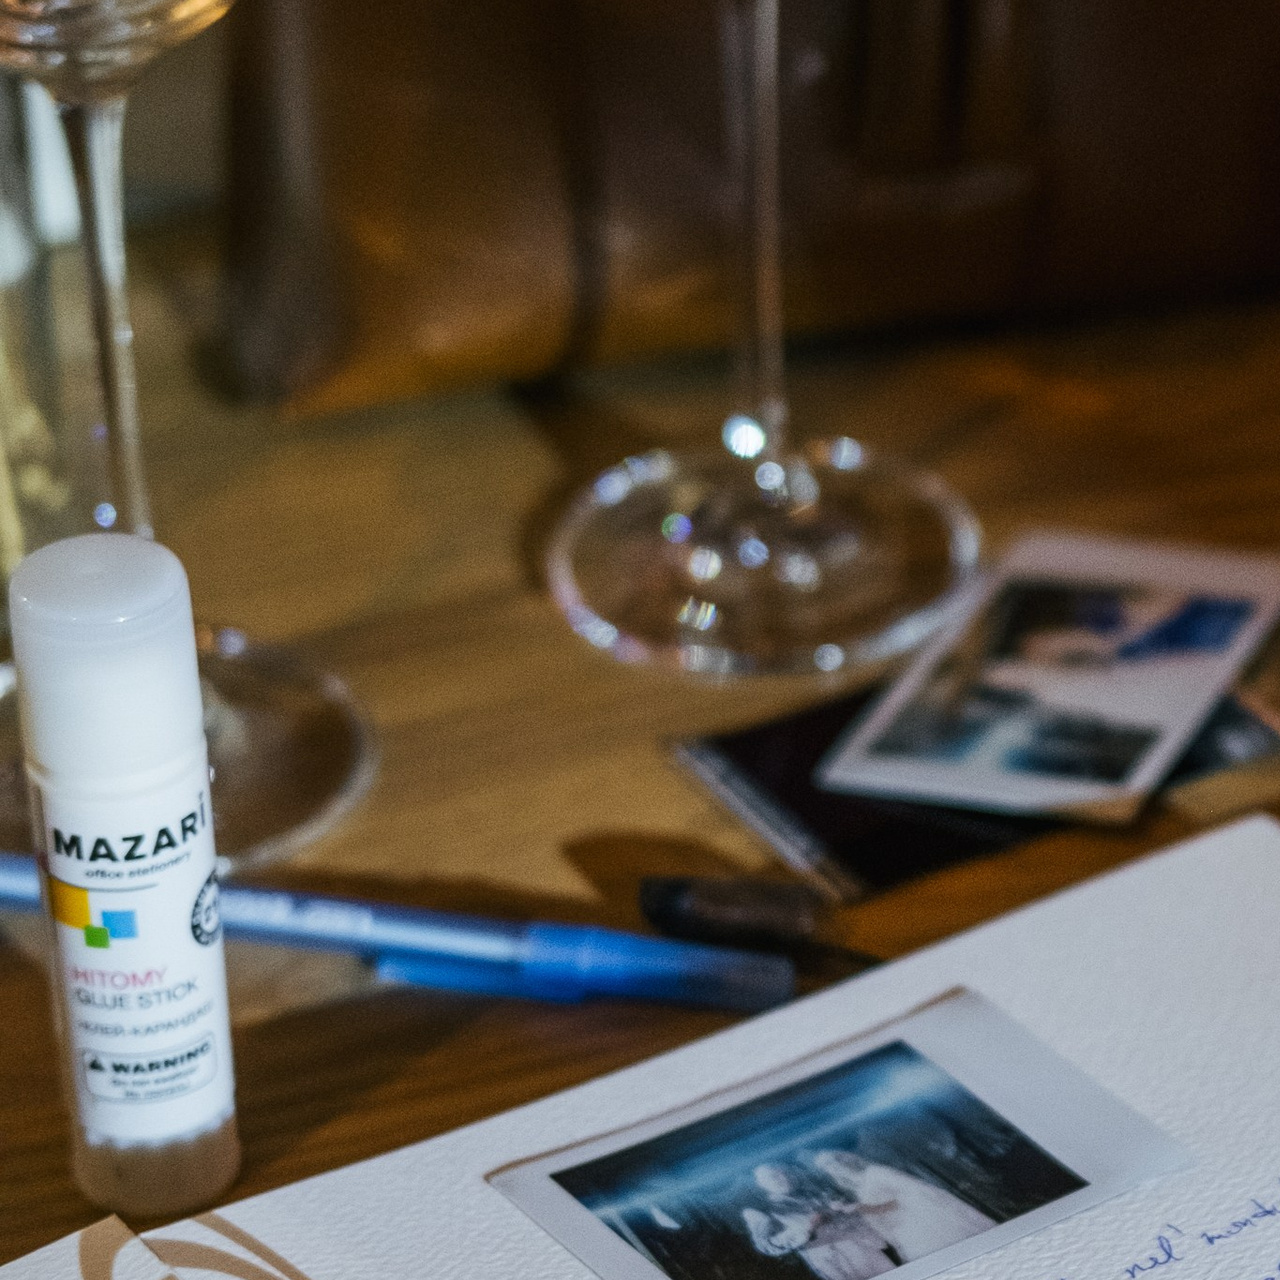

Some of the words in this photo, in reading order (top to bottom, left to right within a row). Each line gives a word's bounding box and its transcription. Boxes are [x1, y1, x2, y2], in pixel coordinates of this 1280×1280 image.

[75, 987, 131, 1011] GLUE
[137, 976, 200, 1010] STICK
[111, 1041, 211, 1073] WARNING
